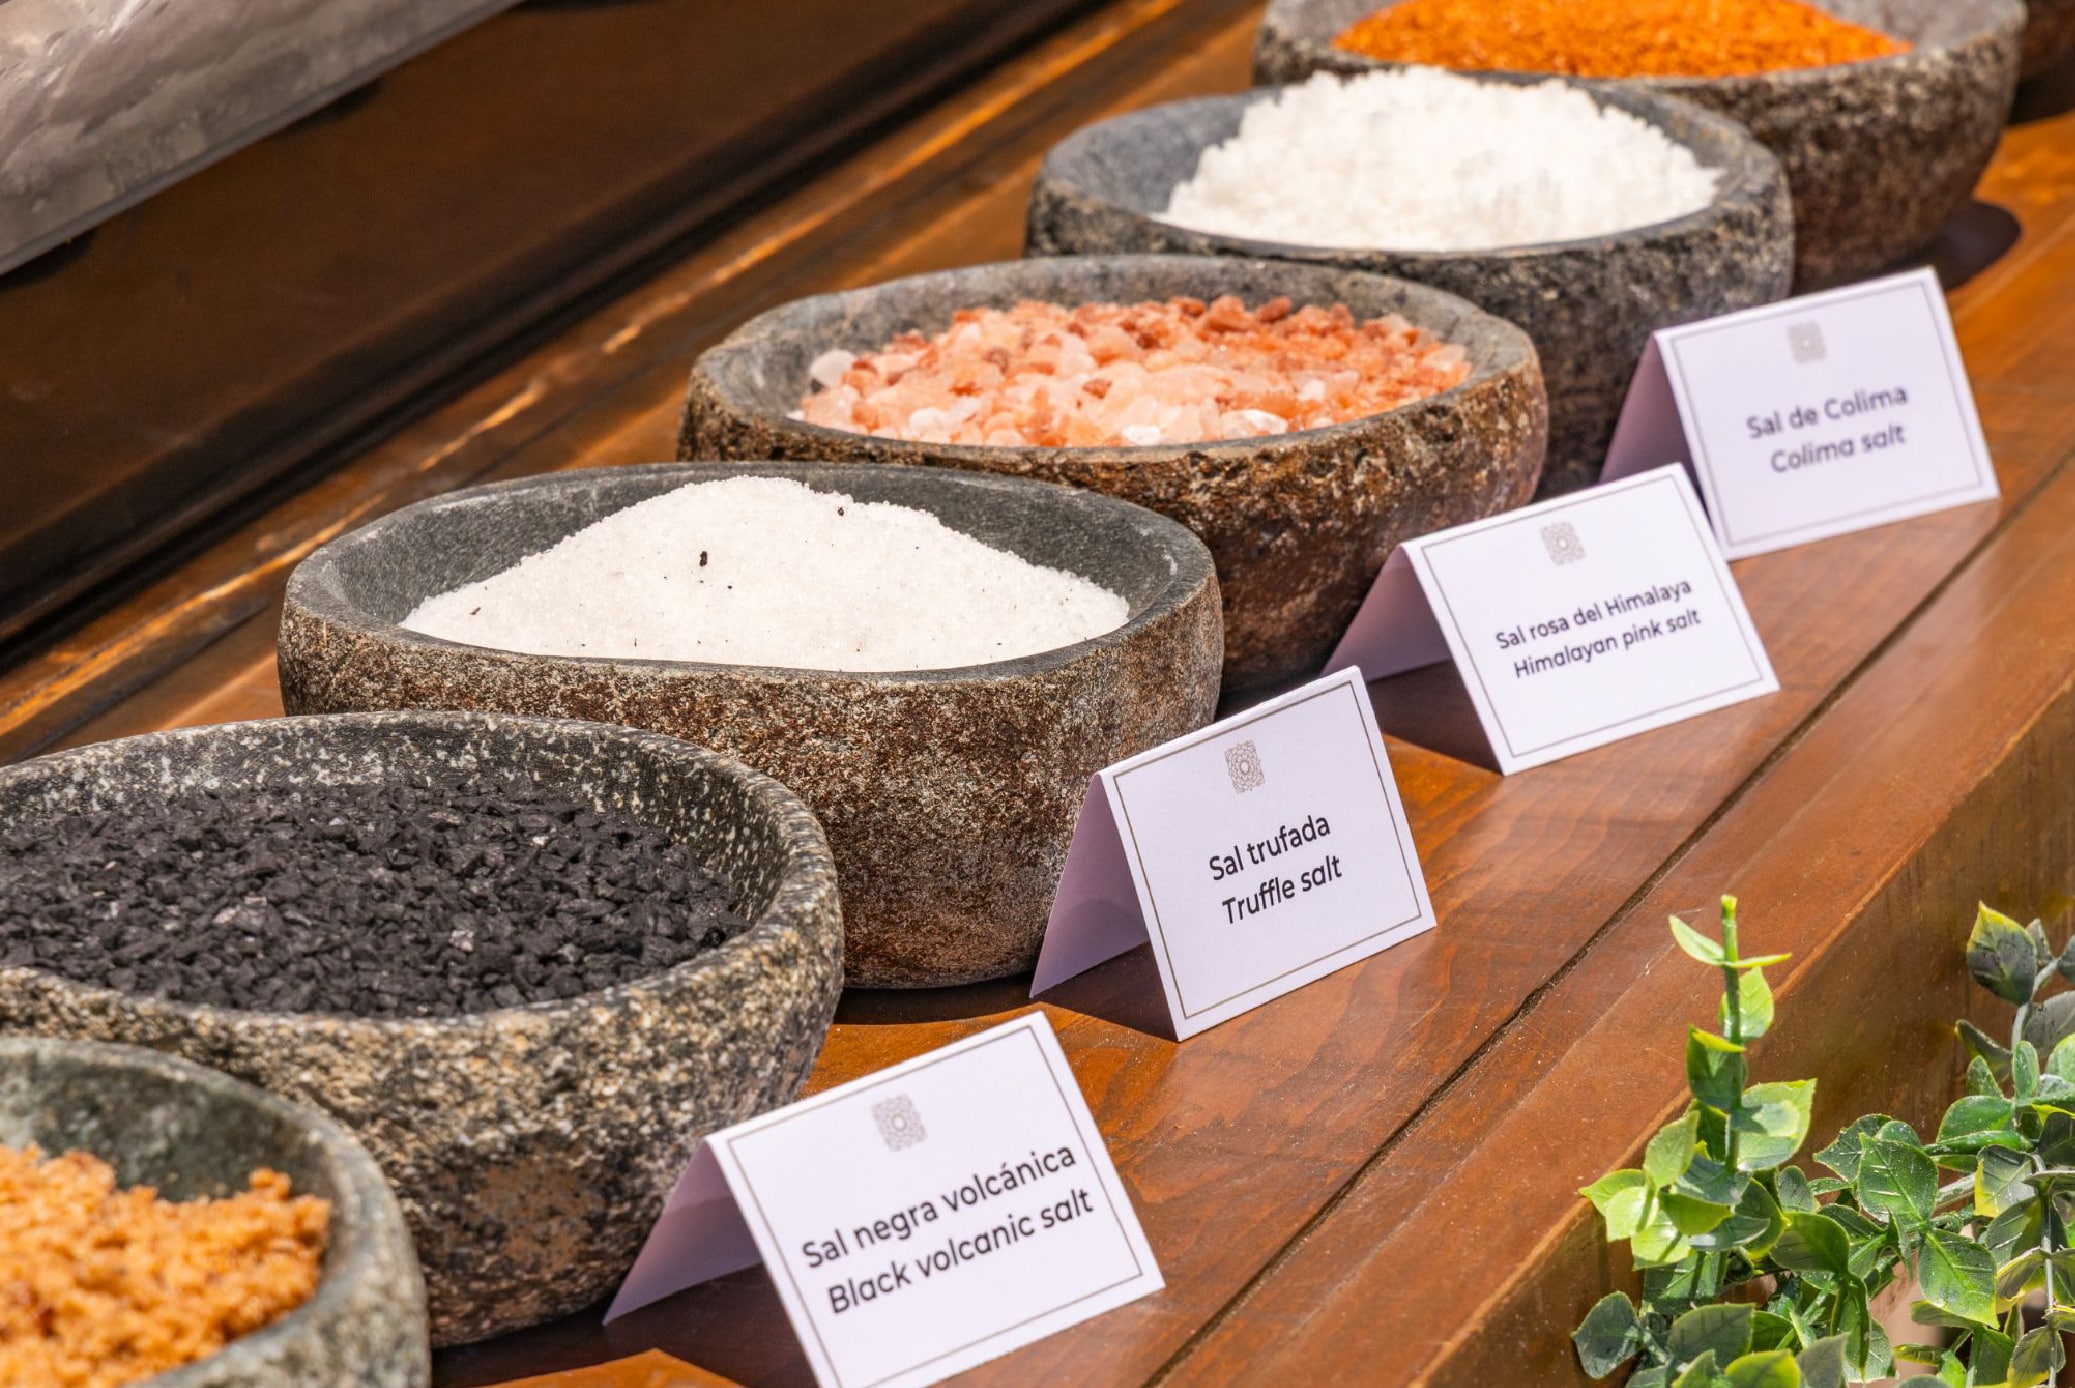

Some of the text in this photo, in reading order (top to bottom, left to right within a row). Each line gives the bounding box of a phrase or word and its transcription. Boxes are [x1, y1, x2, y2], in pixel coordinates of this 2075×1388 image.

[1747, 387, 1908, 439] Sal de Colima
[1770, 425, 1905, 473] Colima salt
[1496, 581, 1692, 649] Sal rosa del Himalaya
[1514, 609, 1701, 678] Himalayan pink salt
[1209, 815, 1331, 881] Sal trufada
[1222, 855, 1343, 925] Truffle salt
[802, 1147, 1076, 1269] Sal negra volcánica
[828, 1189, 1094, 1314] Black volcanic salt
